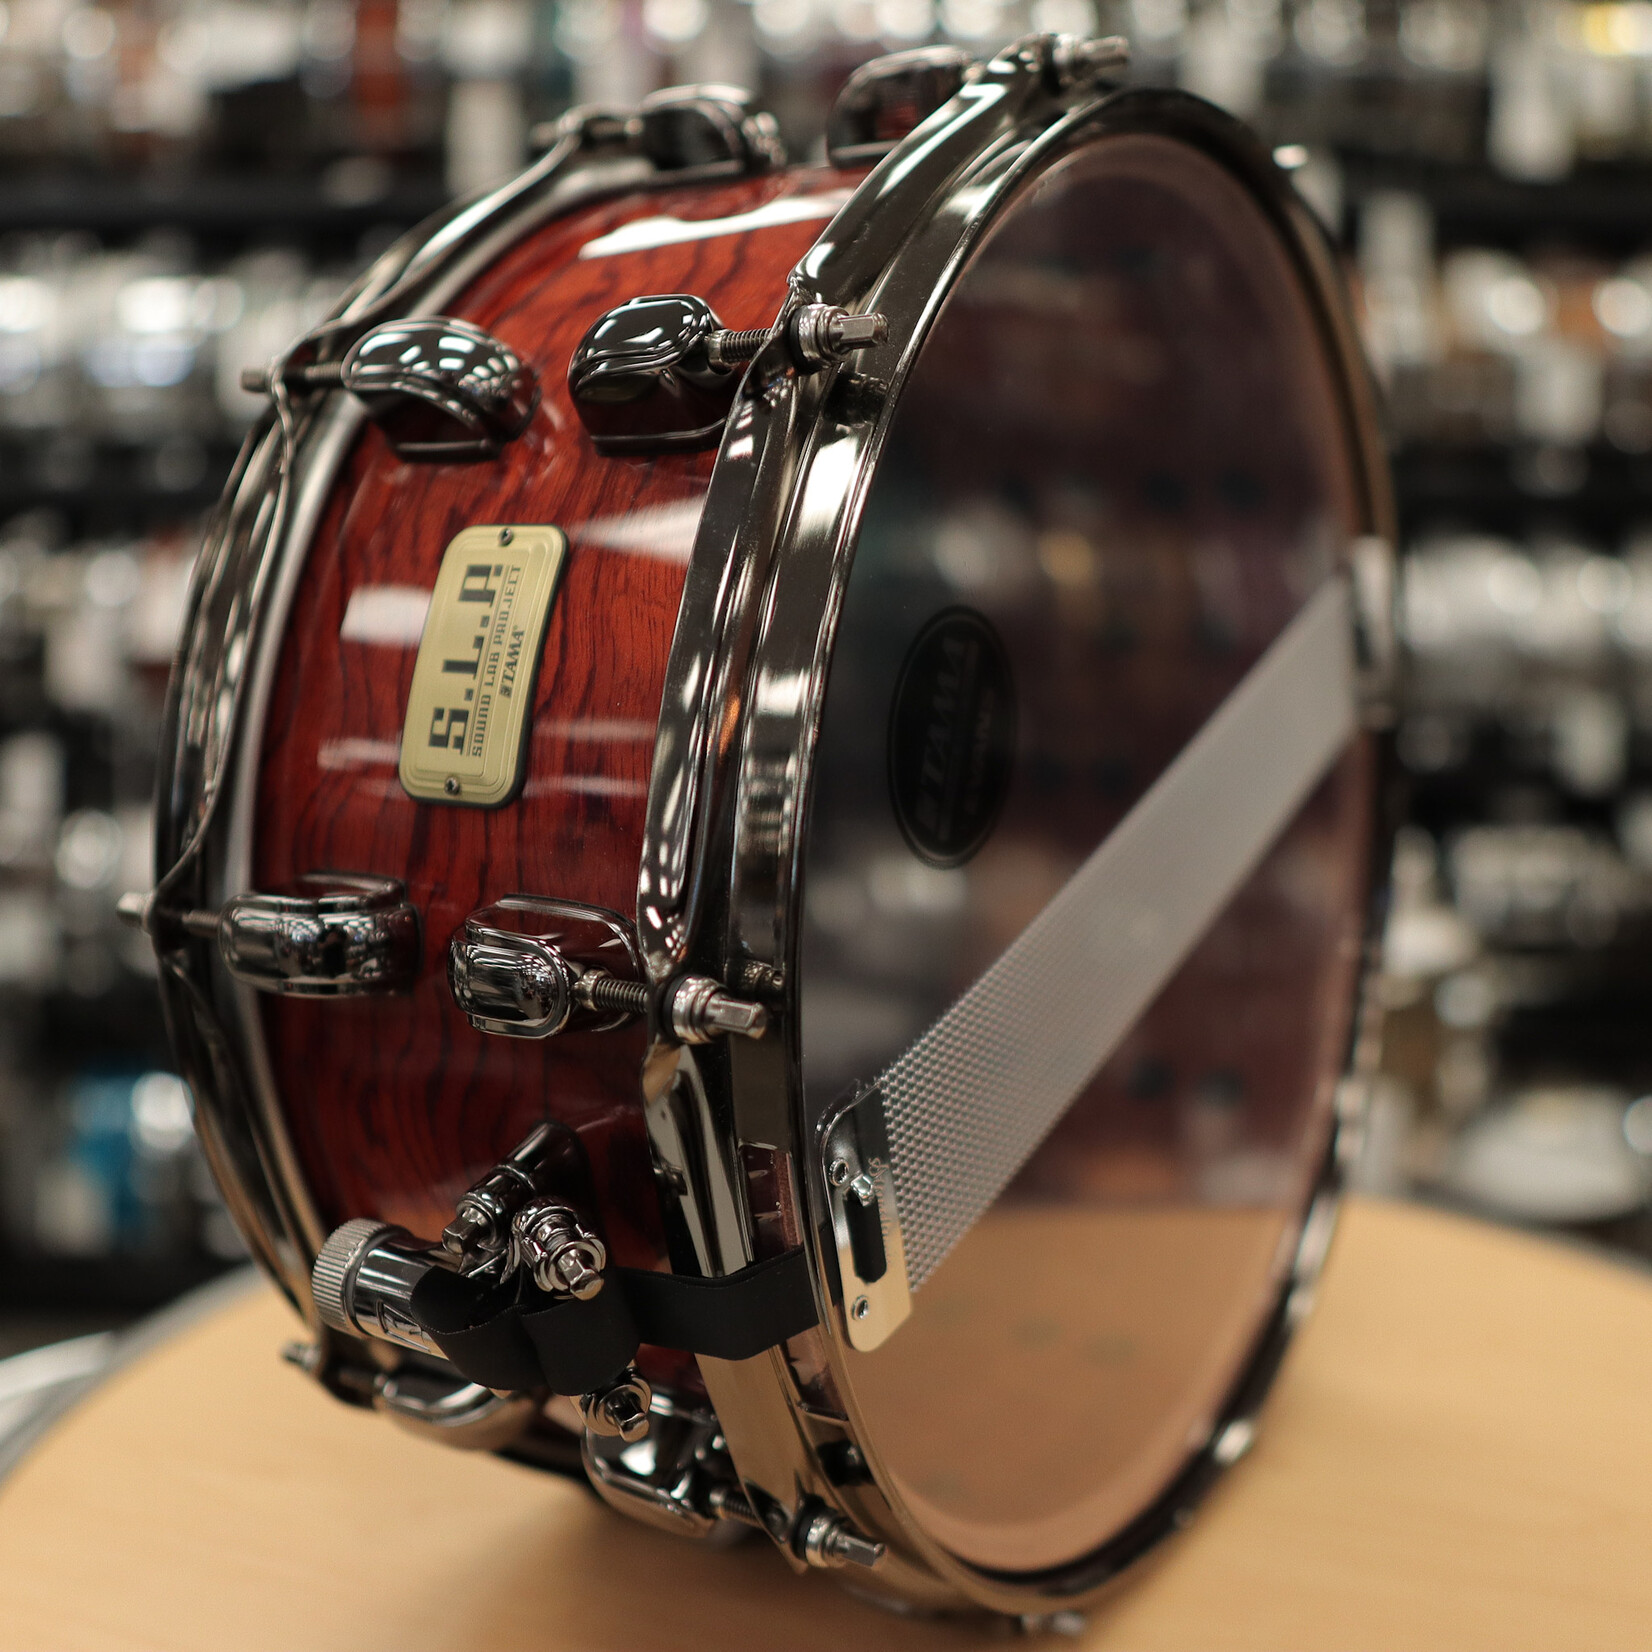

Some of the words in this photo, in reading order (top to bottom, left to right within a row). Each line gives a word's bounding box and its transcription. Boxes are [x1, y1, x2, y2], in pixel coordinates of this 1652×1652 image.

[471, 694, 491, 757] SOUND
[483, 651, 500, 687] LAB
[493, 565, 521, 646] PROJECT
[920, 637, 966, 786] TAMA
